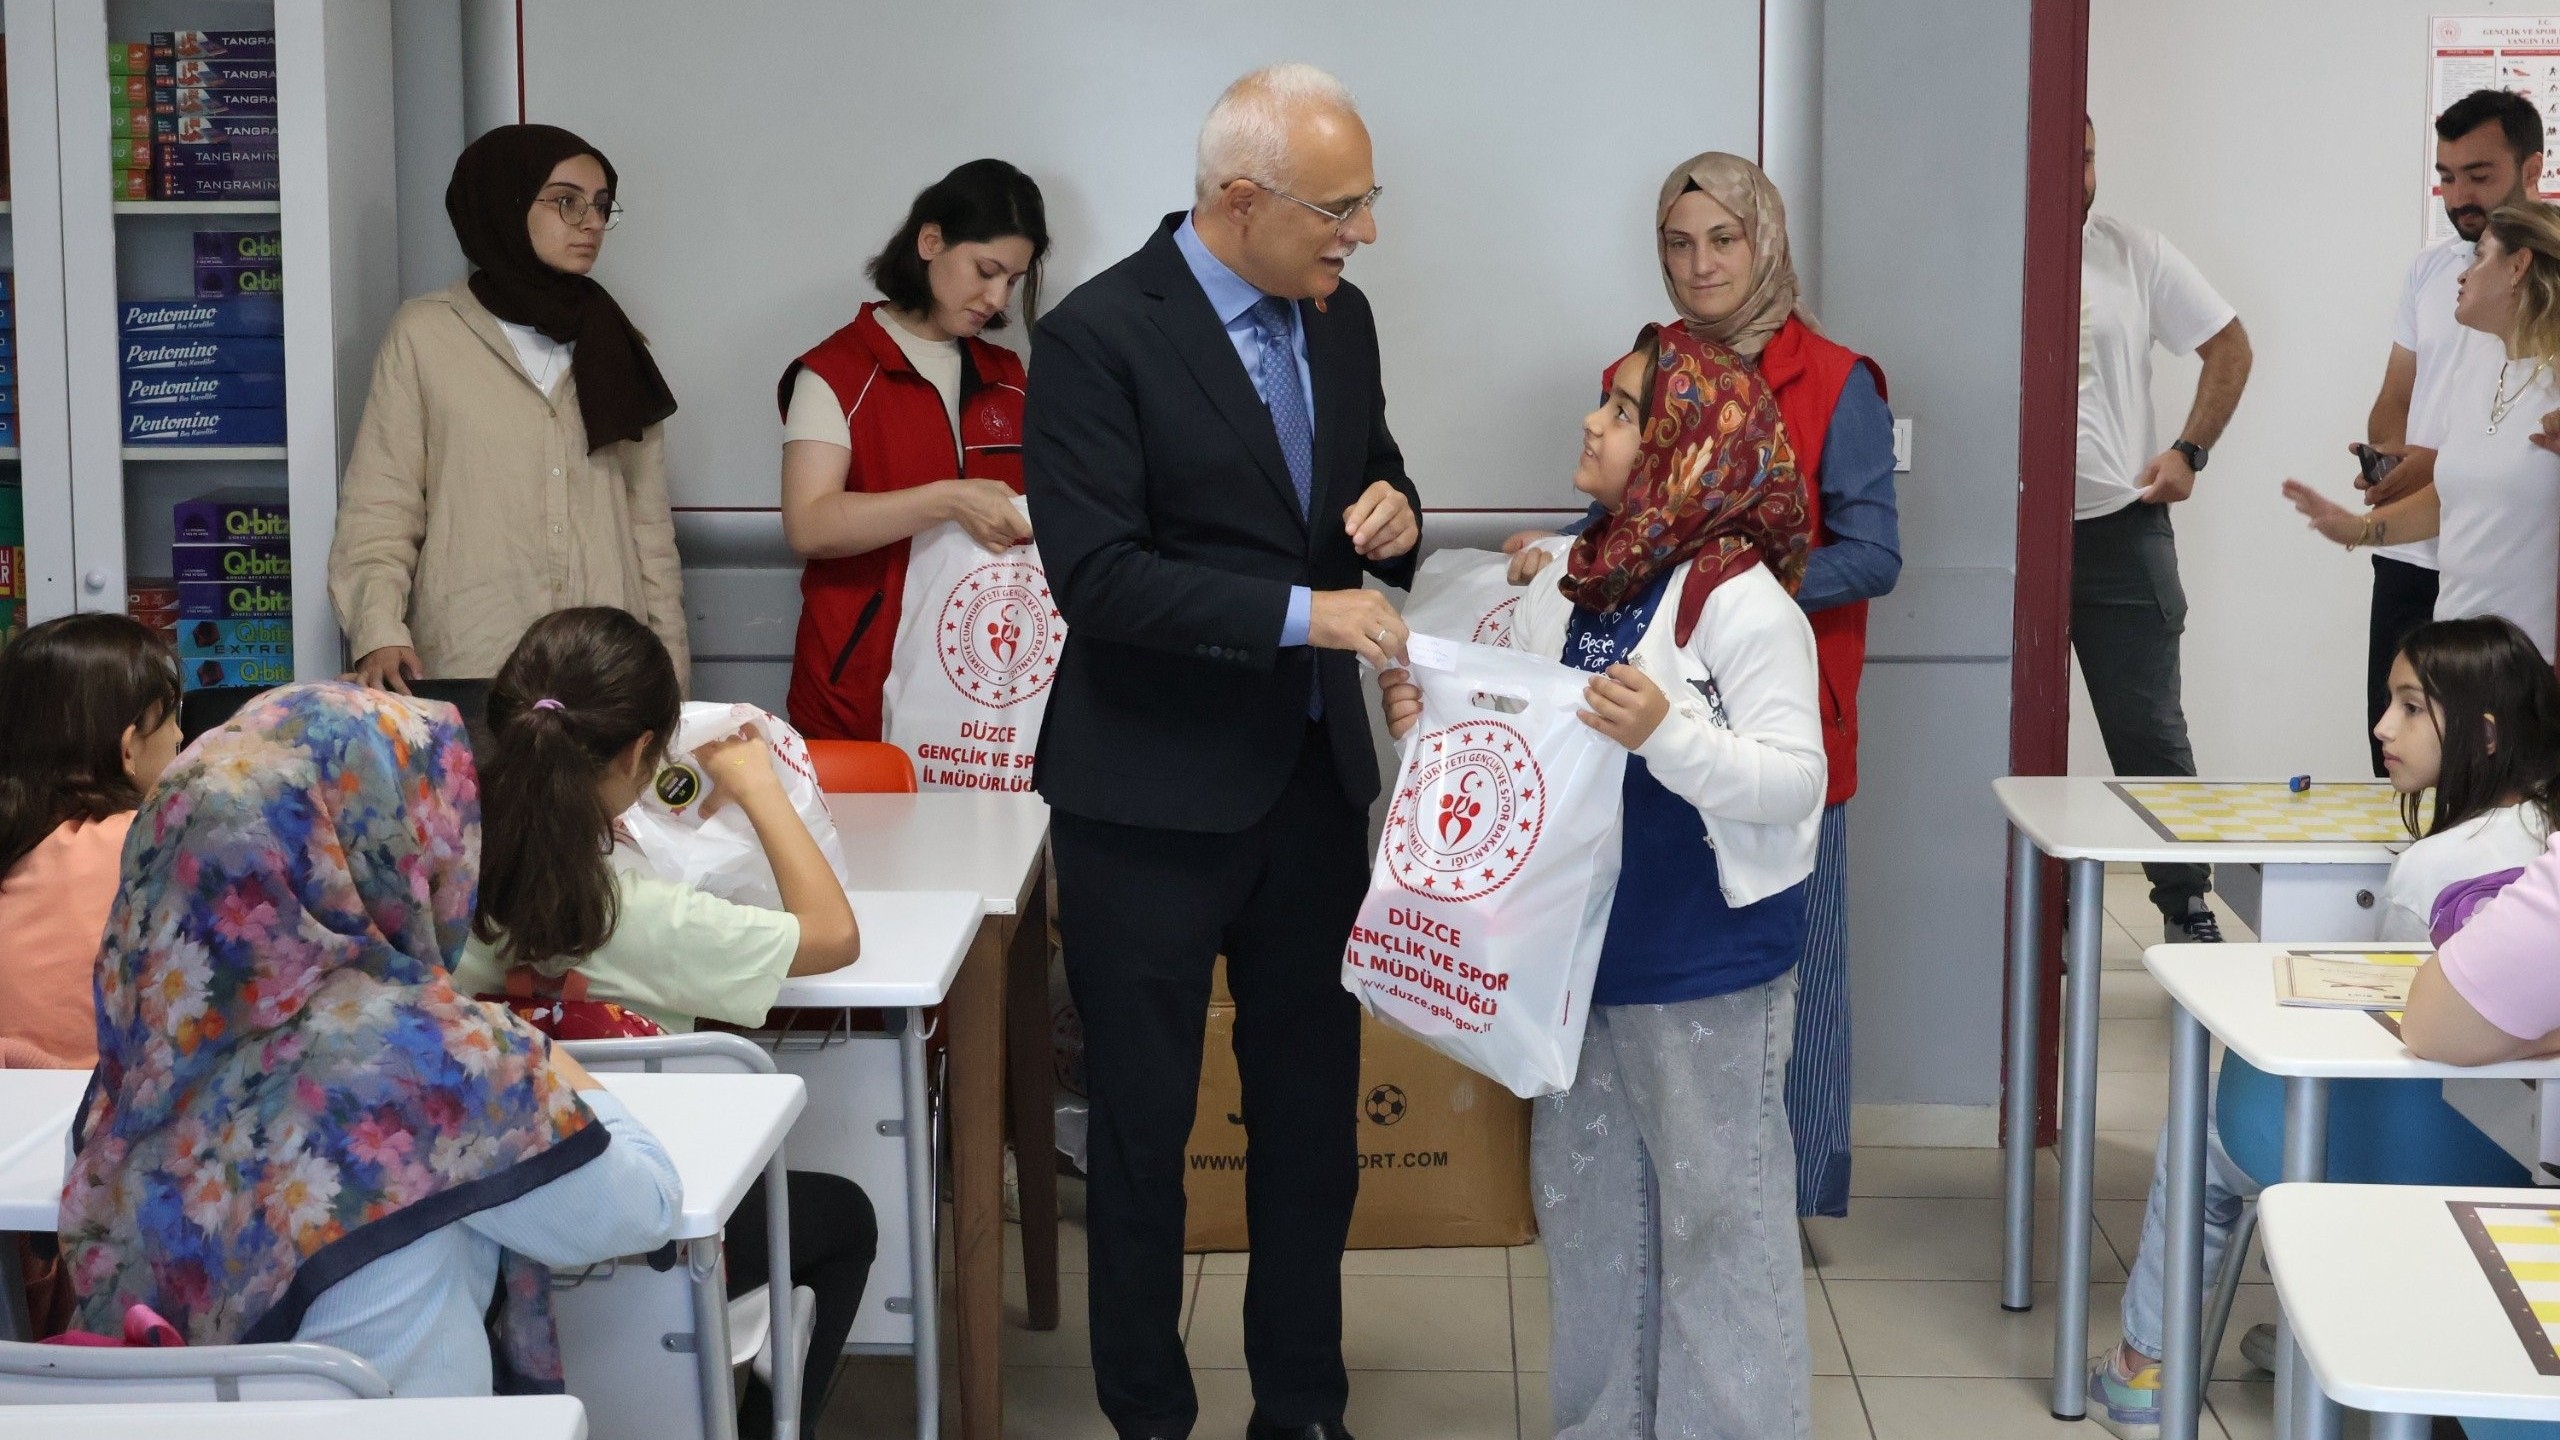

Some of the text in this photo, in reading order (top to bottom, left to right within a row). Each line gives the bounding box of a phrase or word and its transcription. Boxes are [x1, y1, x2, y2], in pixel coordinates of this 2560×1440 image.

[222, 37, 276, 45] TANGRA
[223, 70, 277, 79] TANGRA
[223, 95, 278, 104] TANGRA
[225, 127, 278, 136] TANGRA
[196, 152, 279, 161] TANGRAMIN
[197, 180, 280, 190] TANGRAMIN
[125, 304, 218, 325] Pentomino
[126, 341, 219, 363] Pentomino
[128, 376, 220, 398] Pentomino
[129, 411, 221, 432] Pentomino
[1027, 599, 1038, 611] VE
[1034, 611, 1044, 637] SPOR
[214, 645, 292, 654] EXTRE
[960, 720, 1017, 743] DÜZCE
[918, 743, 1036, 769] GENÇLİK VE SP
[1469, 753, 1502, 774] GENÇLİK
[923, 764, 1033, 793] İL MÜDÜRLÜĞ
[1497, 774, 1507, 787] VE
[1500, 788, 1511, 822] SPOR
[1451, 823, 1507, 868] BAKANLIĞI
[1388, 907, 1461, 948] DÜZCE
[1350, 924, 1510, 992] ENÇLİK VE SPOR
[1347, 945, 1498, 1016] İL MÜDÜRLÜĞÜ
